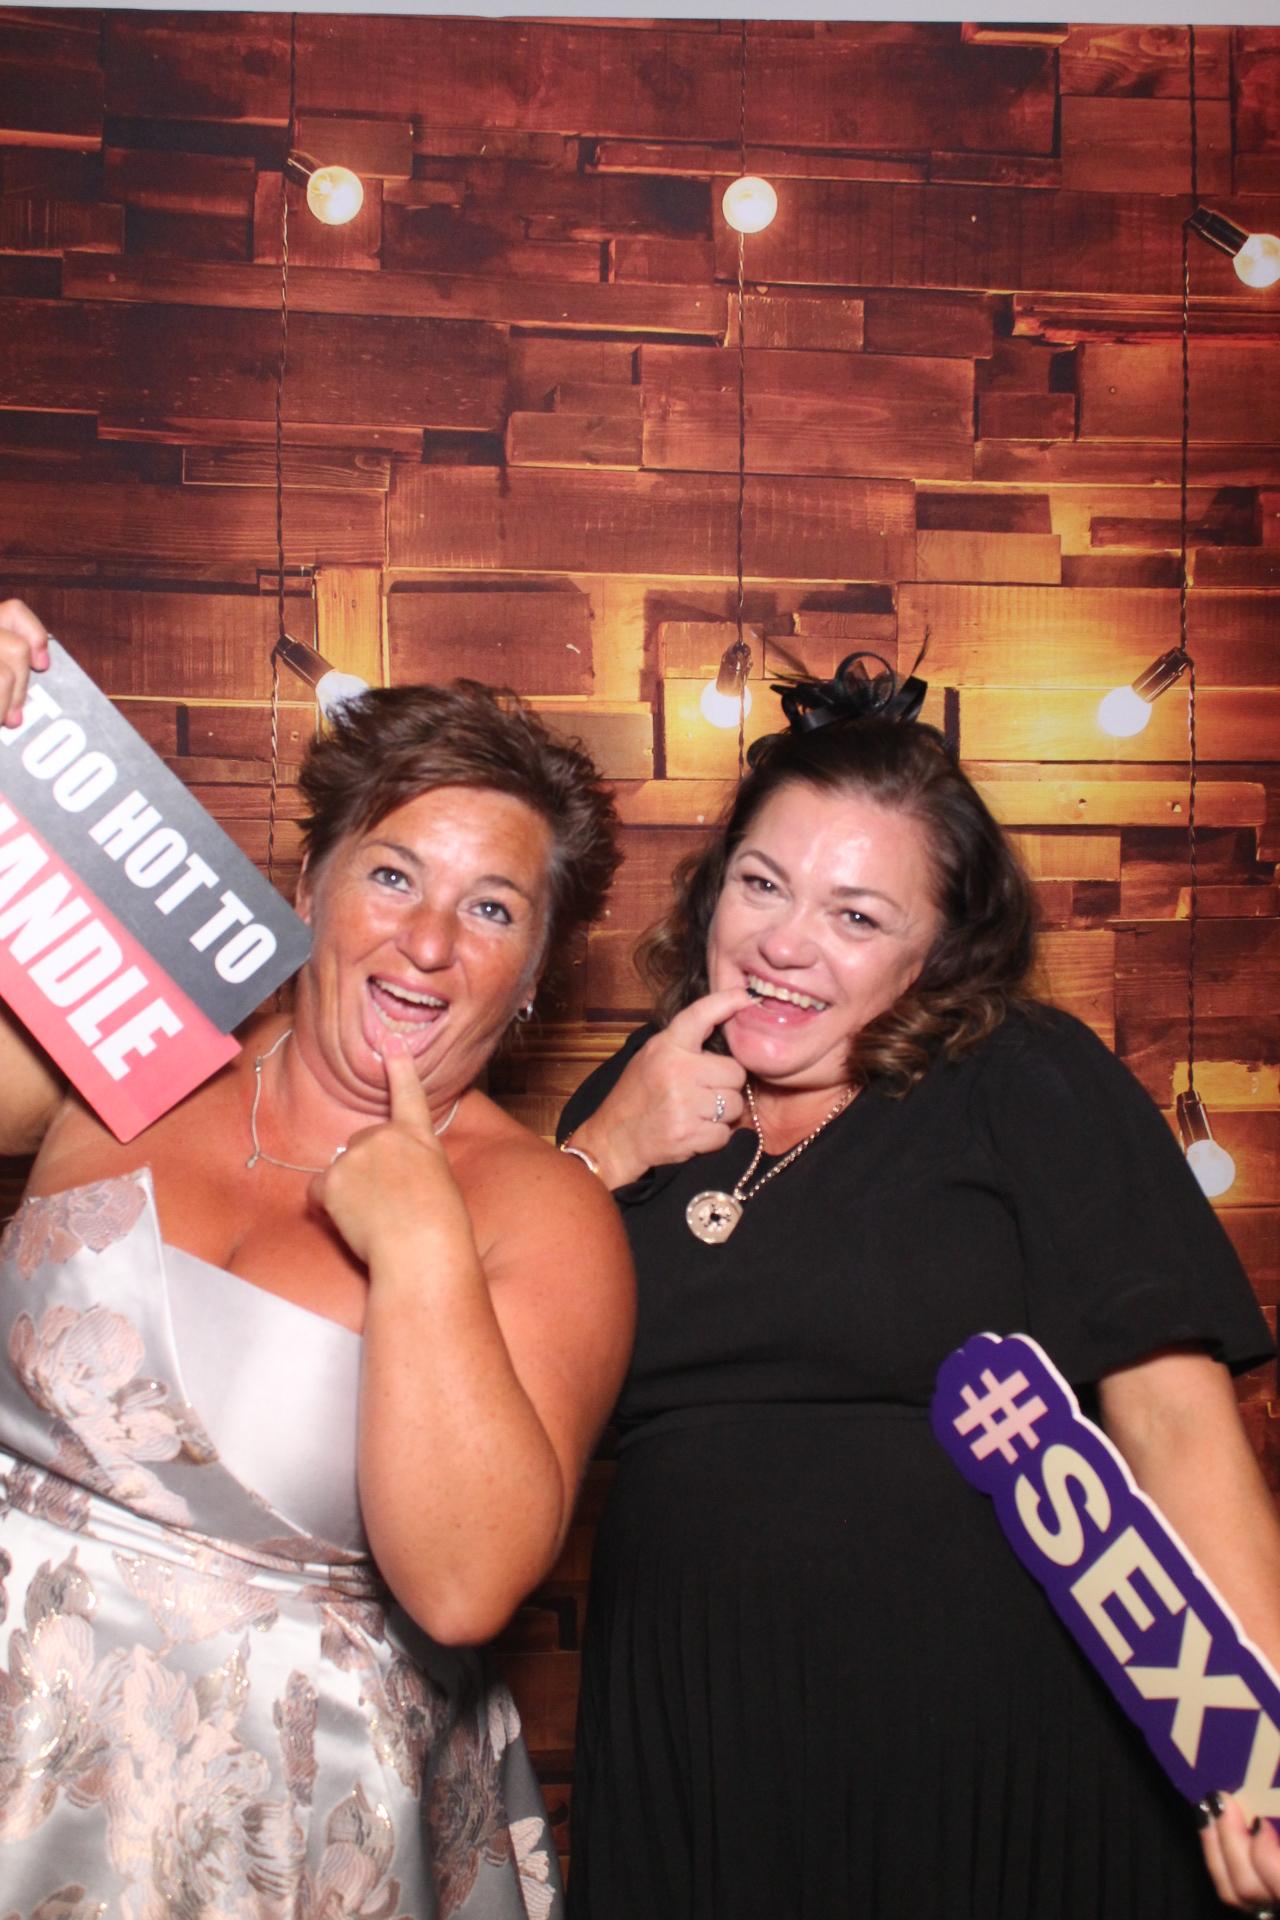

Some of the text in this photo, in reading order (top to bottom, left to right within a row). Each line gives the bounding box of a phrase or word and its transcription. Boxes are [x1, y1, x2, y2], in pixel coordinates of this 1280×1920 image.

[0, 683, 278, 984] TOO HOT TO
[0, 802, 184, 1082] ANDLE
